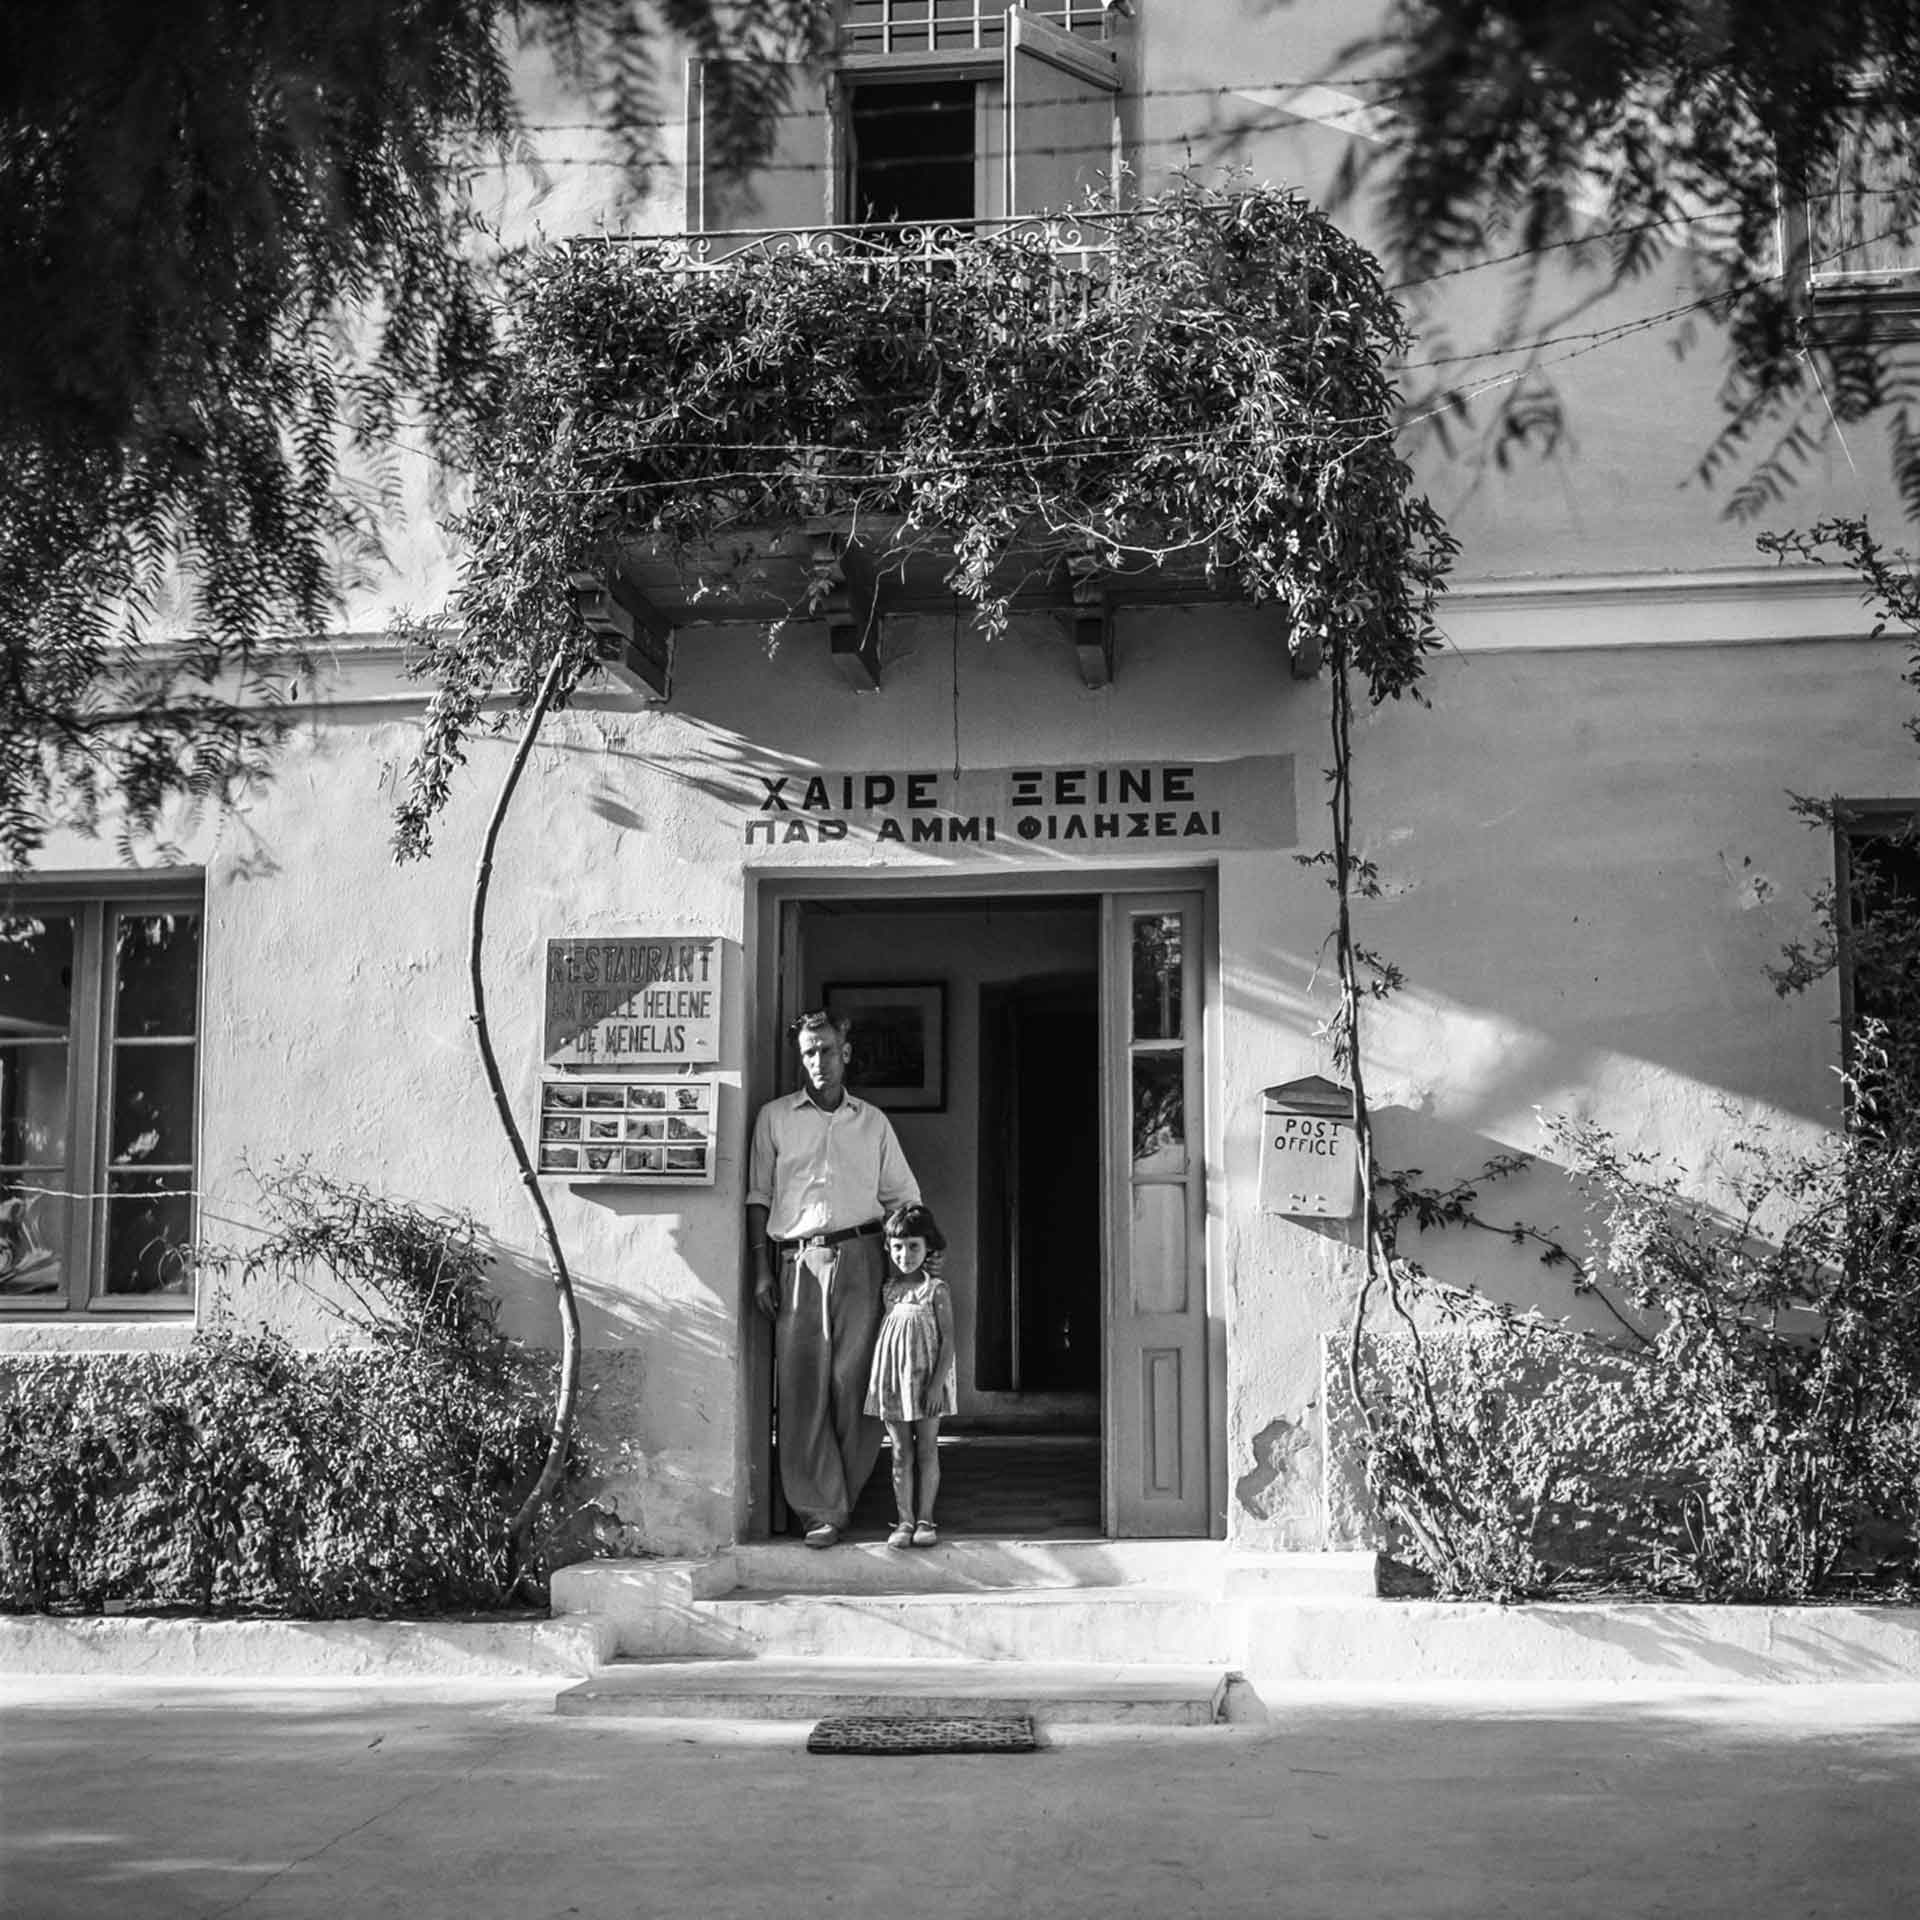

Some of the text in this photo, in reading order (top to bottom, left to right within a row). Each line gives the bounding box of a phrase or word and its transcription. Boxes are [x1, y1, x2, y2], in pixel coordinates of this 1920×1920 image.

[761, 768, 1195, 810] ΧΑΙΡΕ ΞΕΙΝΕ
[876, 816, 996, 843] ΑΜΜΙ
[1017, 810, 1221, 840] ΦΙΛΗΣΕΑΙ
[549, 944, 713, 983] RESTAURANT
[606, 1025, 685, 1053] MENELAS
[1285, 1118, 1342, 1138] POST
[1274, 1136, 1339, 1156] OFFICE
